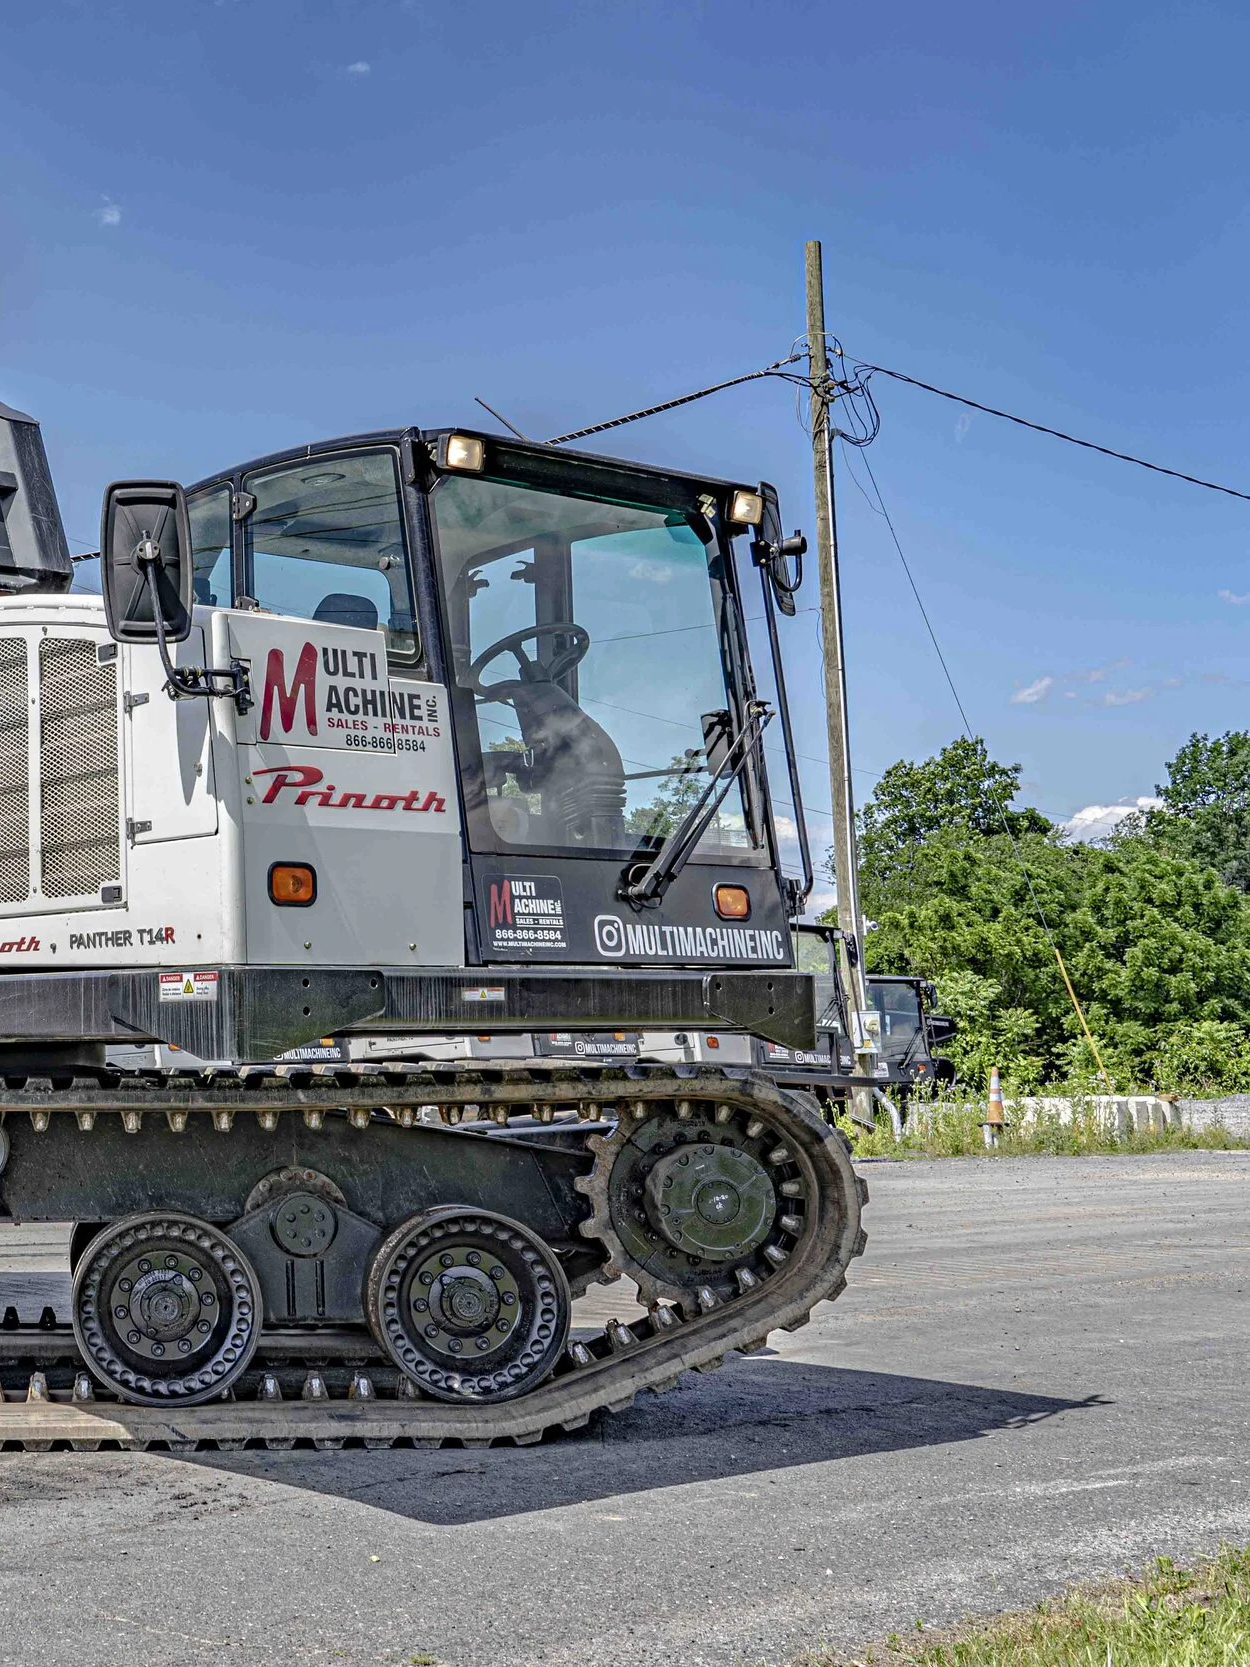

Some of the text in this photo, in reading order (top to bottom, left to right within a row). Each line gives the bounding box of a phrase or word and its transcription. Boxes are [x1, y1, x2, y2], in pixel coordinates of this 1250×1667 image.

[426, 695, 439, 723] INC.
[327, 717, 368, 731] SALES
[383, 722, 441, 737] RENTALS
[252, 765, 447, 813] Prinoth
[69, 926, 176, 950] PANTHER T14R
[495, 929, 562, 940] 866-866-8584
[625, 923, 784, 960] MULTIMACHINEINC
